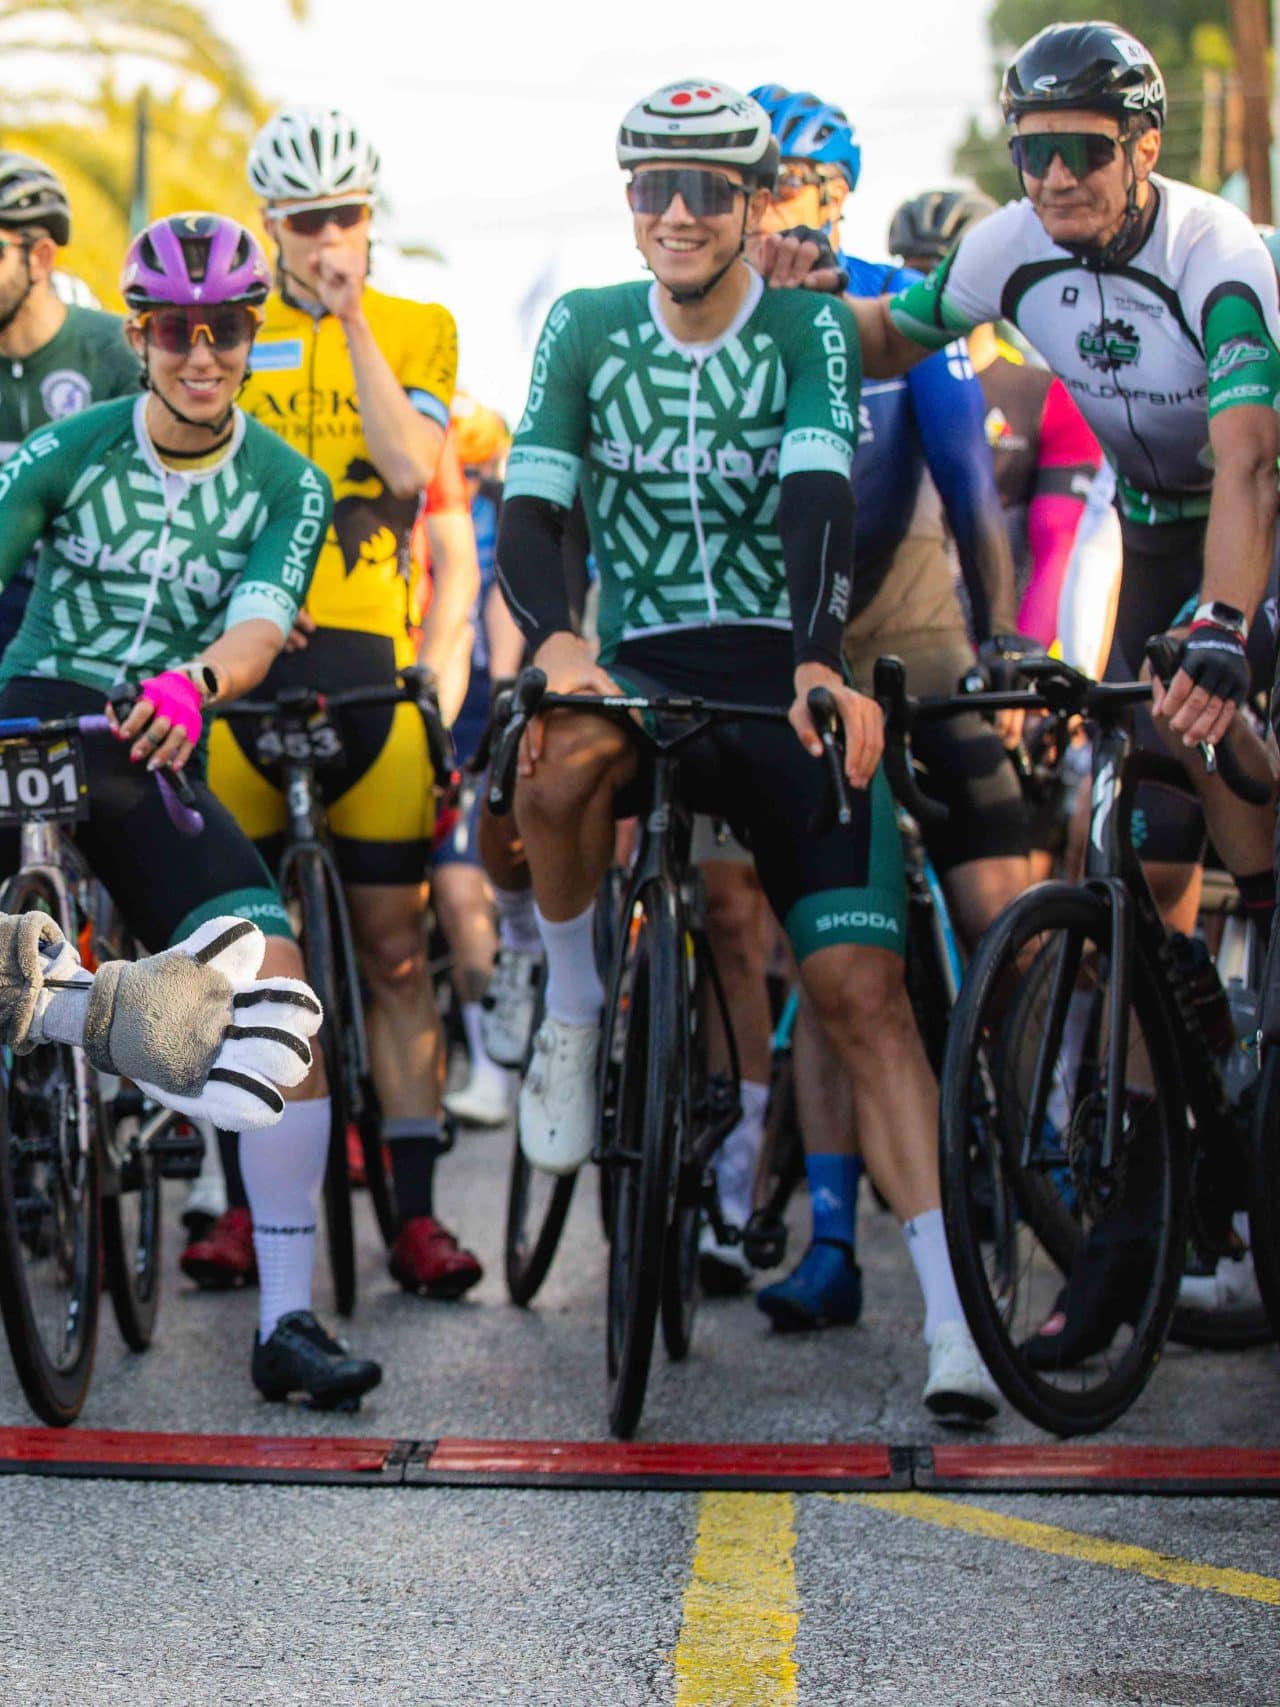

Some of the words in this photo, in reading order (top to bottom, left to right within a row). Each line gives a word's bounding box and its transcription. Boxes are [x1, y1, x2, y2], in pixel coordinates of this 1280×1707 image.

[813, 304, 855, 433] SKODA
[281, 467, 326, 593] SKODA
[815, 911, 899, 934] SKODA
